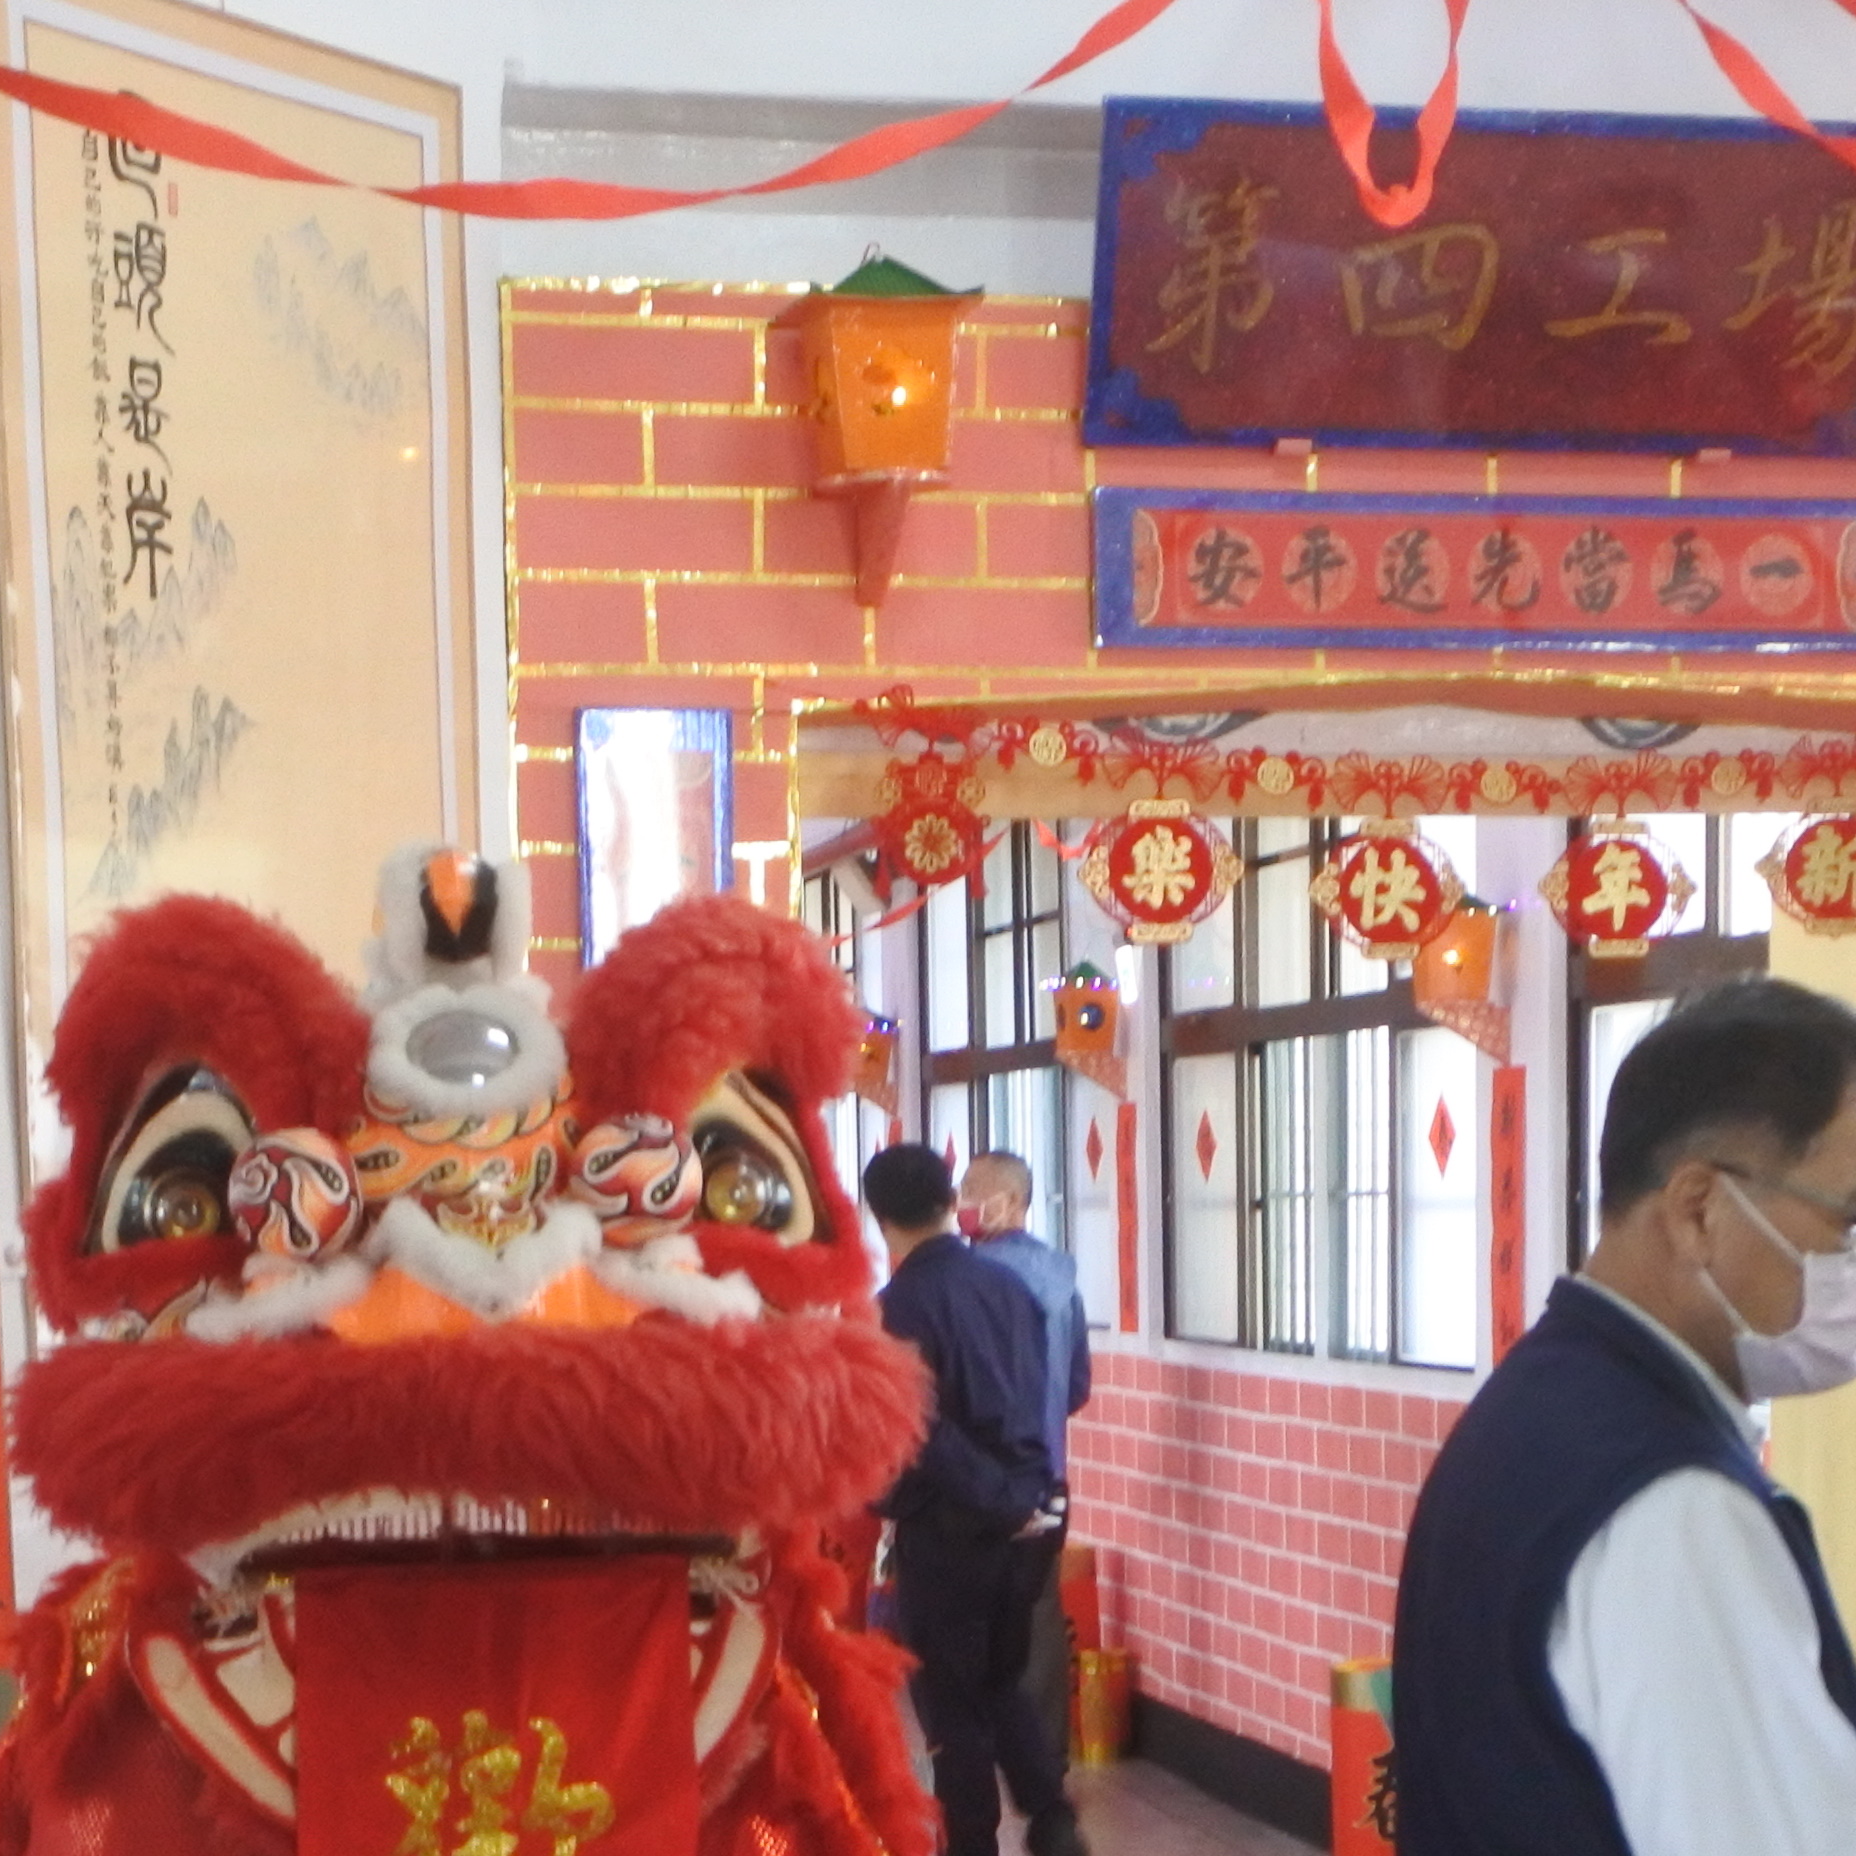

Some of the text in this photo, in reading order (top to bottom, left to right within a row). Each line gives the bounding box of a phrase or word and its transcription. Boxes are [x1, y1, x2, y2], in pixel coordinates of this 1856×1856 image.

[1186, 520, 1806, 617] 一馬當先送平安
